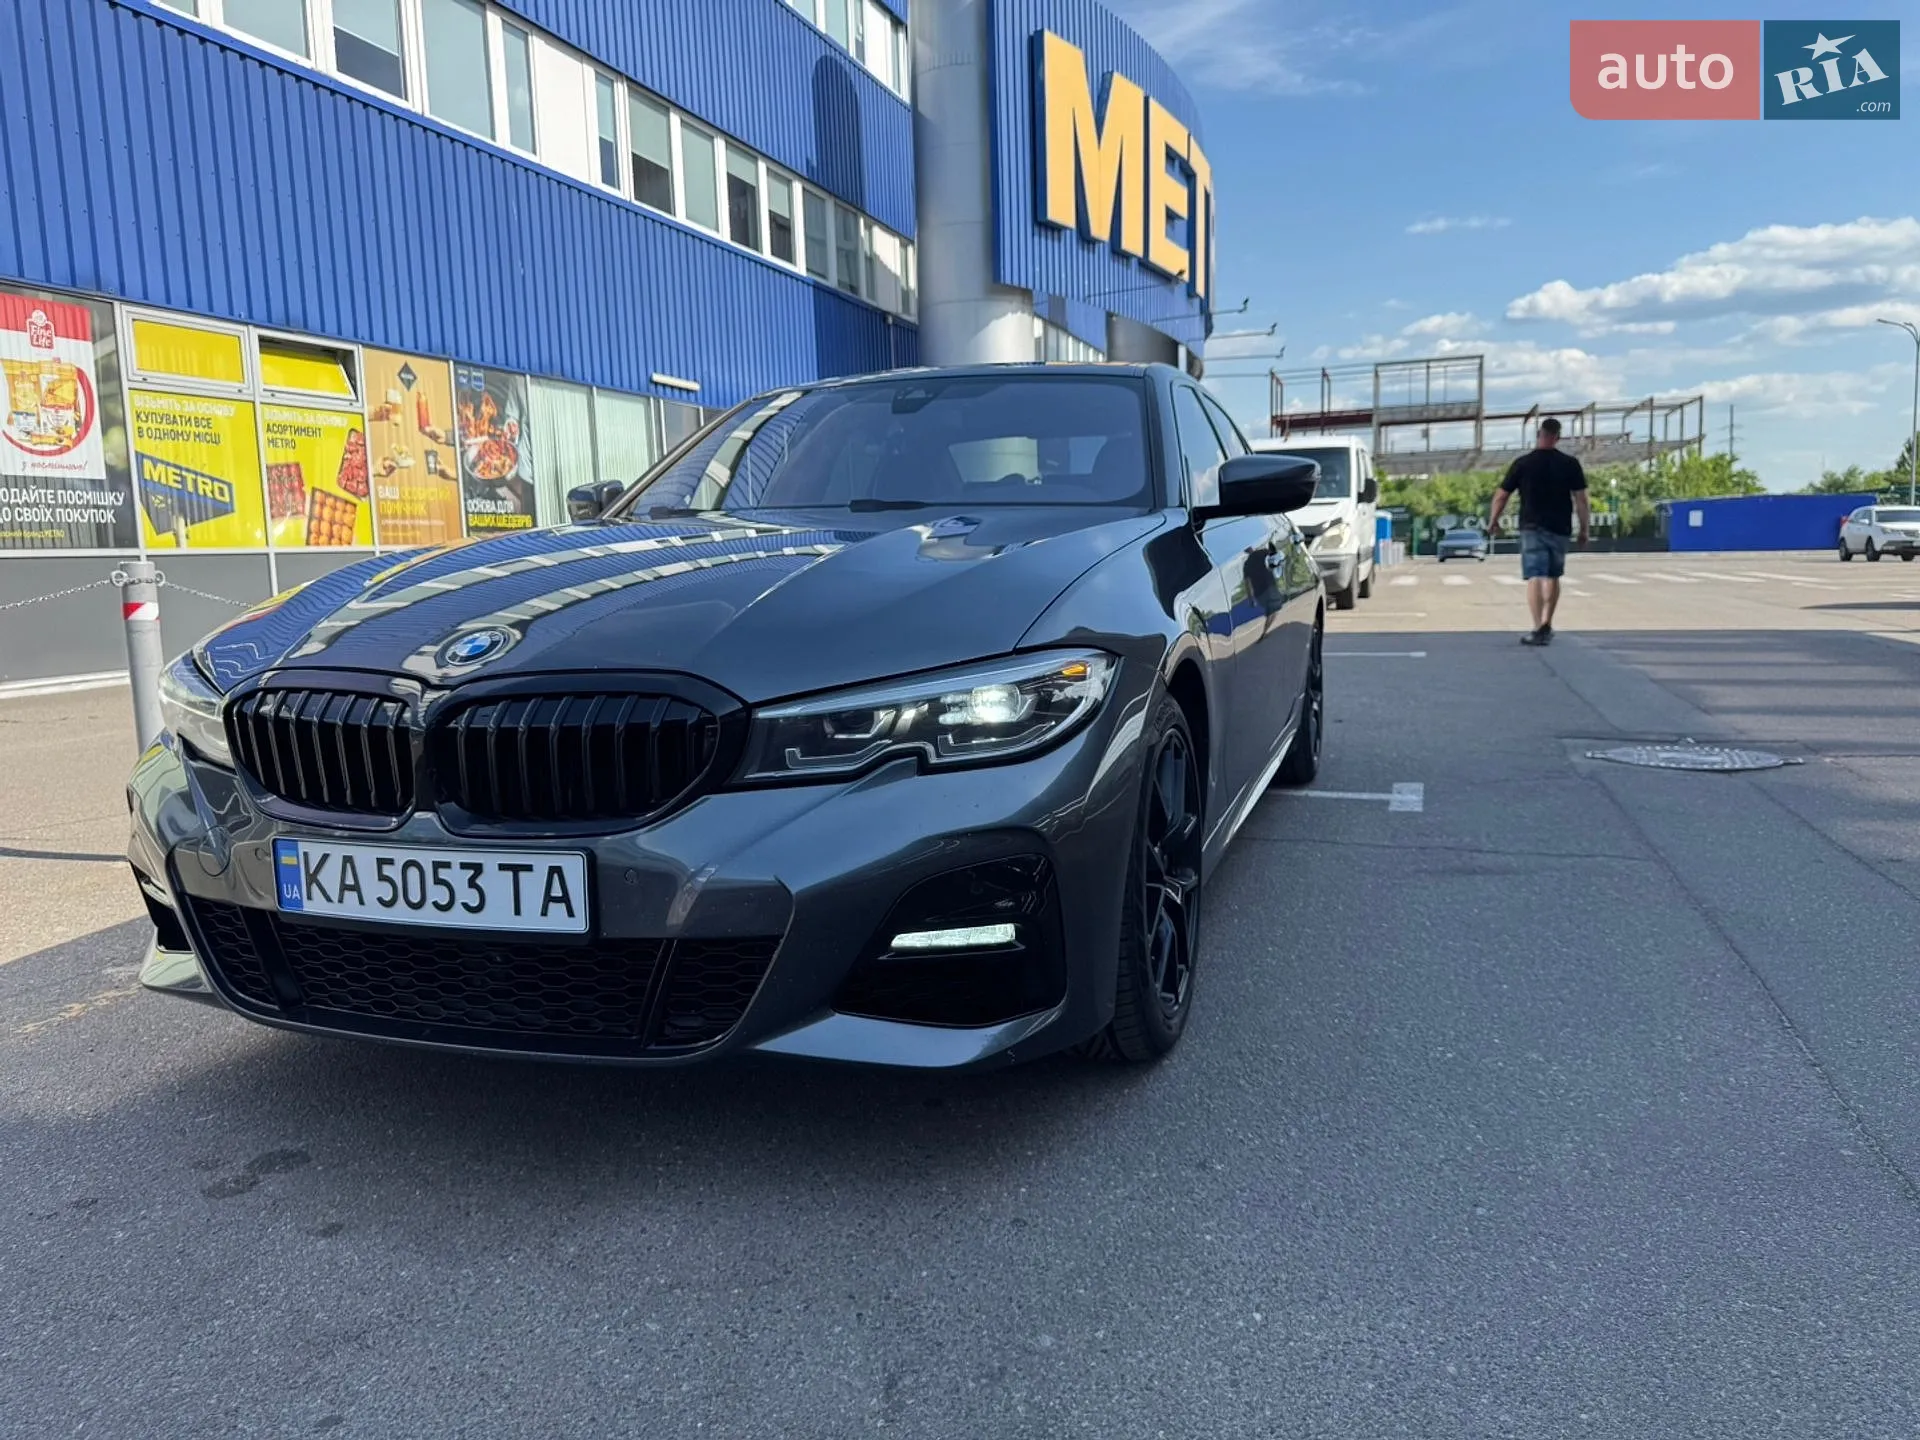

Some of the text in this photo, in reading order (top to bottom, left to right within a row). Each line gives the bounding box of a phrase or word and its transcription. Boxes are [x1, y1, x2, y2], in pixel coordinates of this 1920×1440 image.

[1043, 28, 1215, 312] MET
[135, 410, 213, 430] КУПУВАТИ ВСЕ
[137, 426, 145, 438] В
[146, 427, 192, 442] ОДНОМУ
[266, 423, 322, 438] АСОРТИМЕНТ
[267, 436, 296, 450] METRO
[143, 458, 231, 504] METRO
[57, 489, 125, 506] ПОСМІШКУ
[0, 504, 117, 524] О СВОЇХ ПОКУПОК
[283, 883, 300, 901] UA
[302, 851, 576, 919] KA 5053 TA
